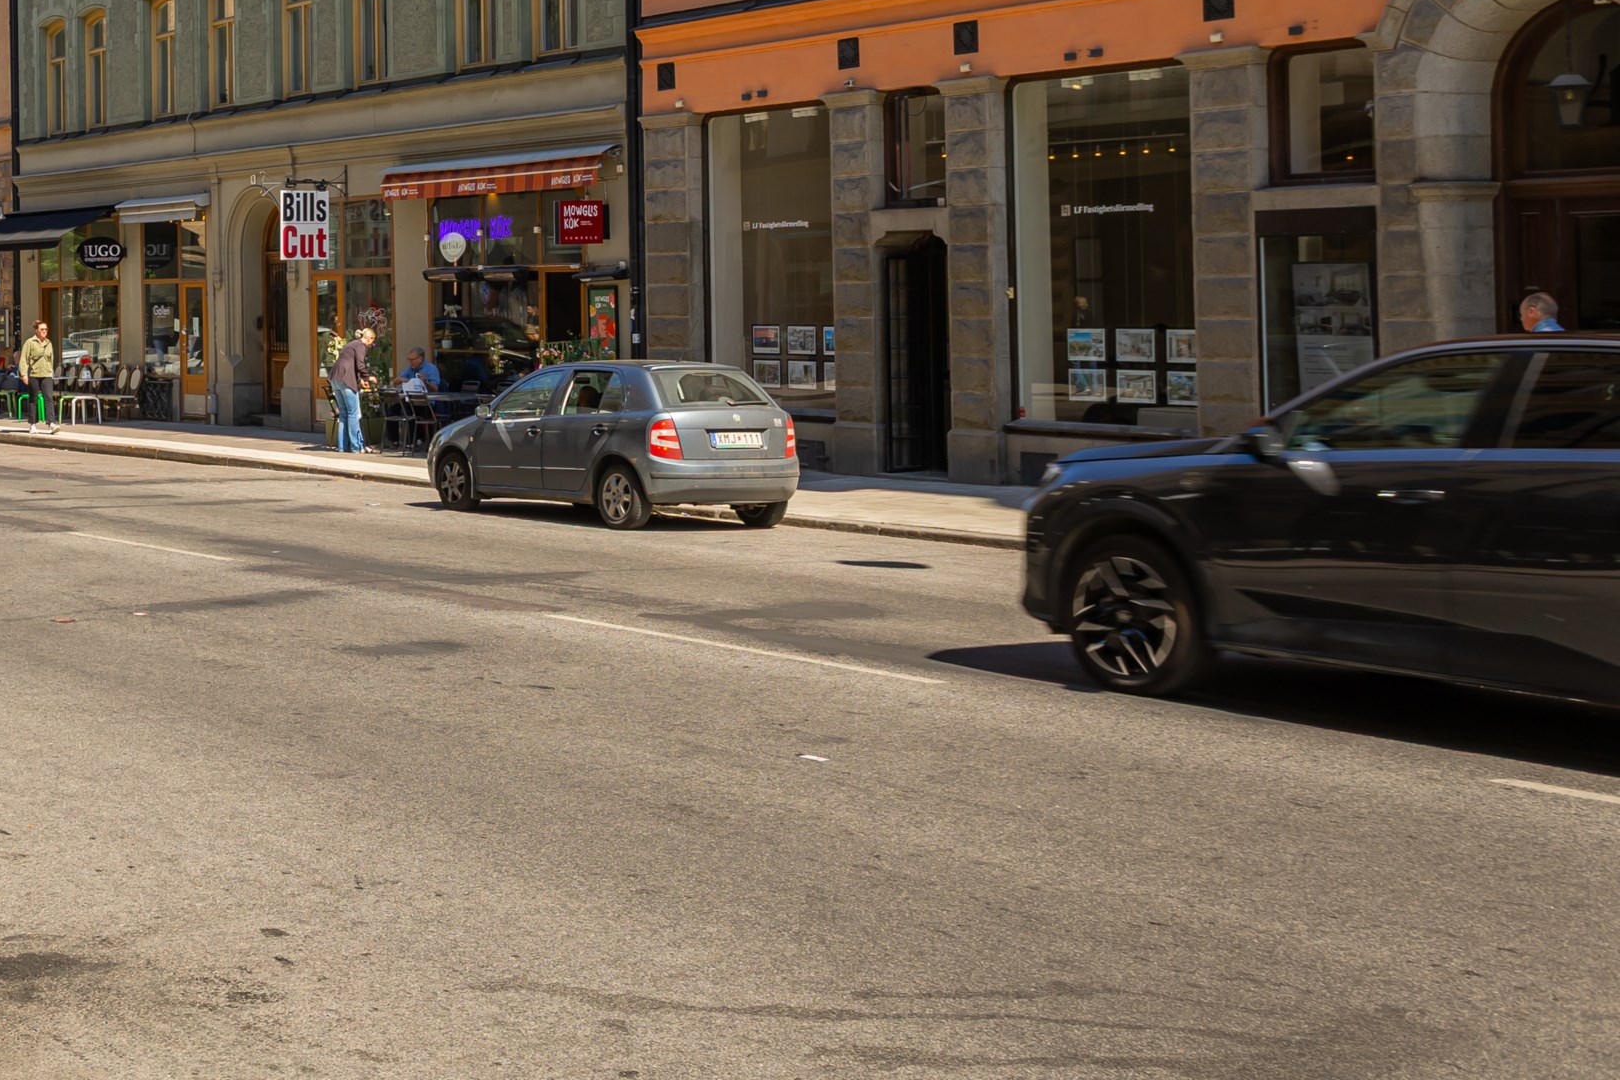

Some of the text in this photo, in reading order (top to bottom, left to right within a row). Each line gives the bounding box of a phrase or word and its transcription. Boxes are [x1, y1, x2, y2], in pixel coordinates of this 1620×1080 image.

[282, 192, 327, 222] Bills
[563, 204, 599, 217] MOWGLIS
[1073, 203, 1154, 215] LF Fastighetsförmedling
[489, 214, 513, 241] KÖK
[563, 217, 580, 229] KÖK
[283, 225, 327, 259] Cut
[88, 244, 121, 257] UGO
[717, 434, 760, 444] XMJ 111
